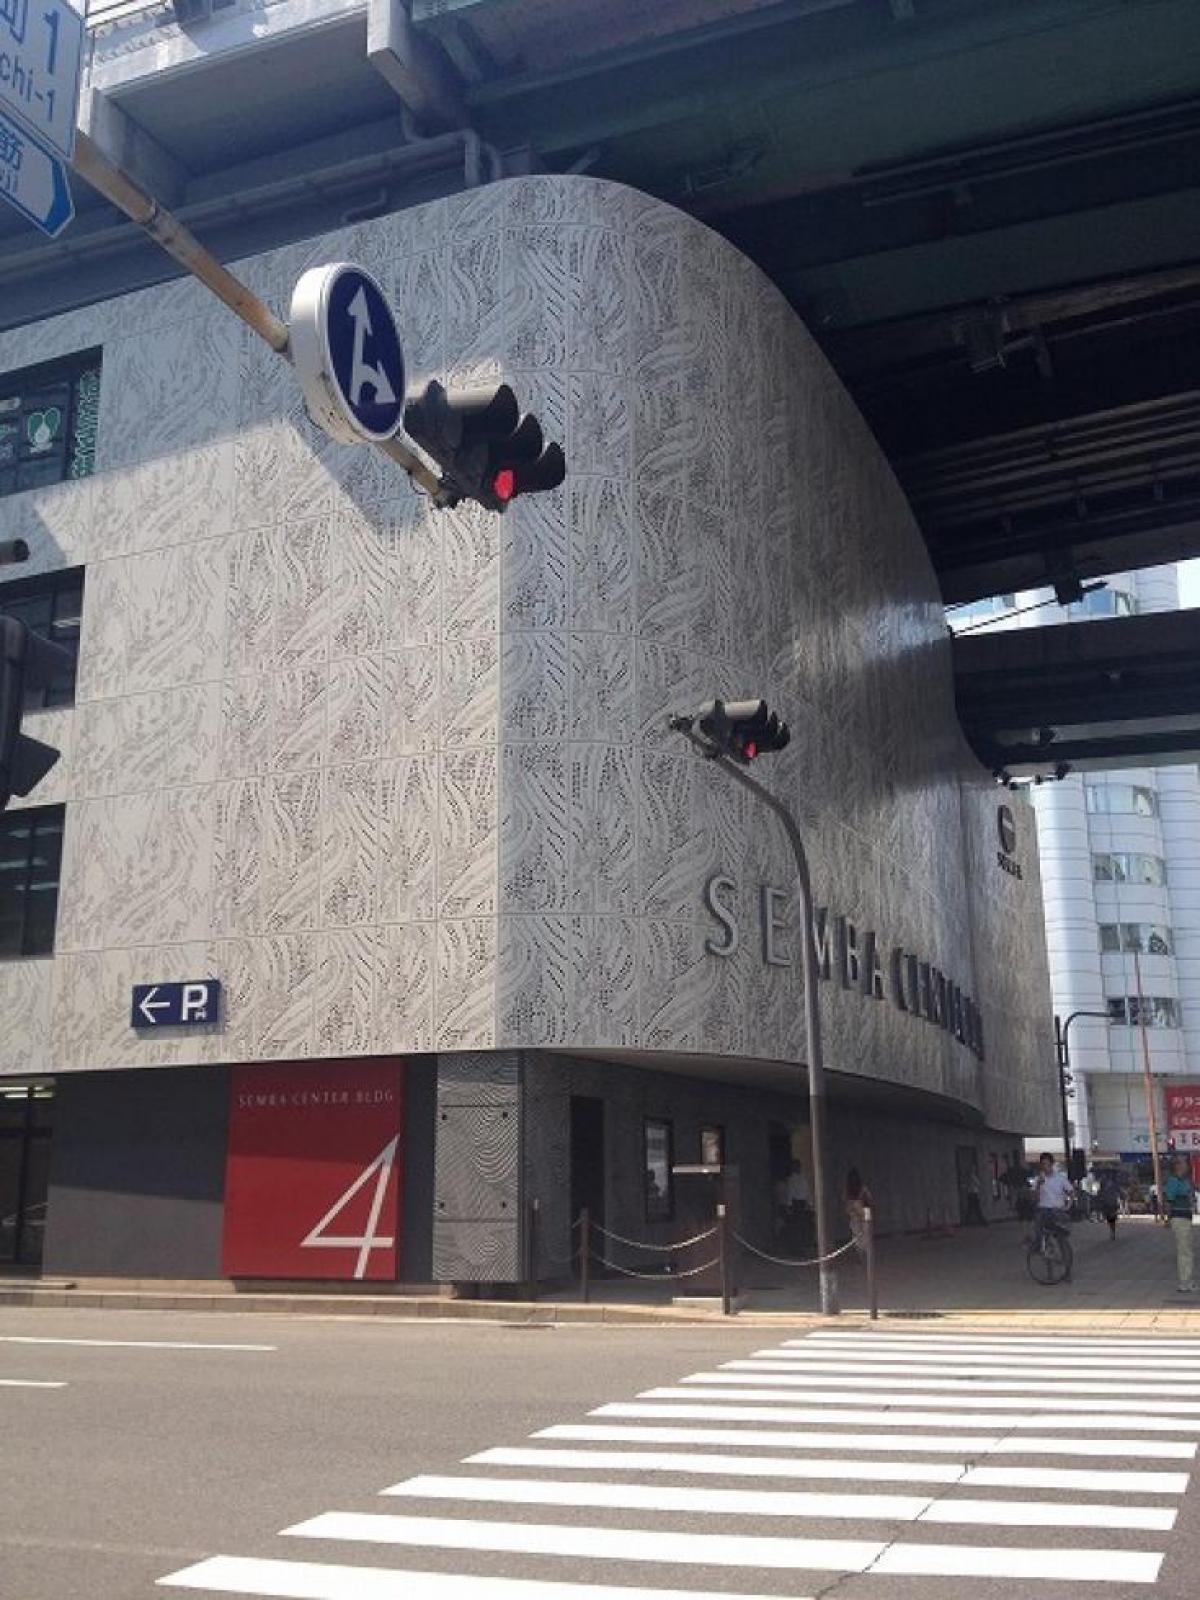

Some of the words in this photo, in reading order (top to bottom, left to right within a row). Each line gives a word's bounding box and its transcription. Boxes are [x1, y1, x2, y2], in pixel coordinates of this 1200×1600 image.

[702, 873, 887, 1001] SEMBA
[182, 984, 208, 1021] P
[239, 1093, 287, 1108] SEMBA
[291, 1091, 349, 1105] CENTER
[356, 1088, 394, 1104] BLDG
[300, 1133, 400, 1279] 4
